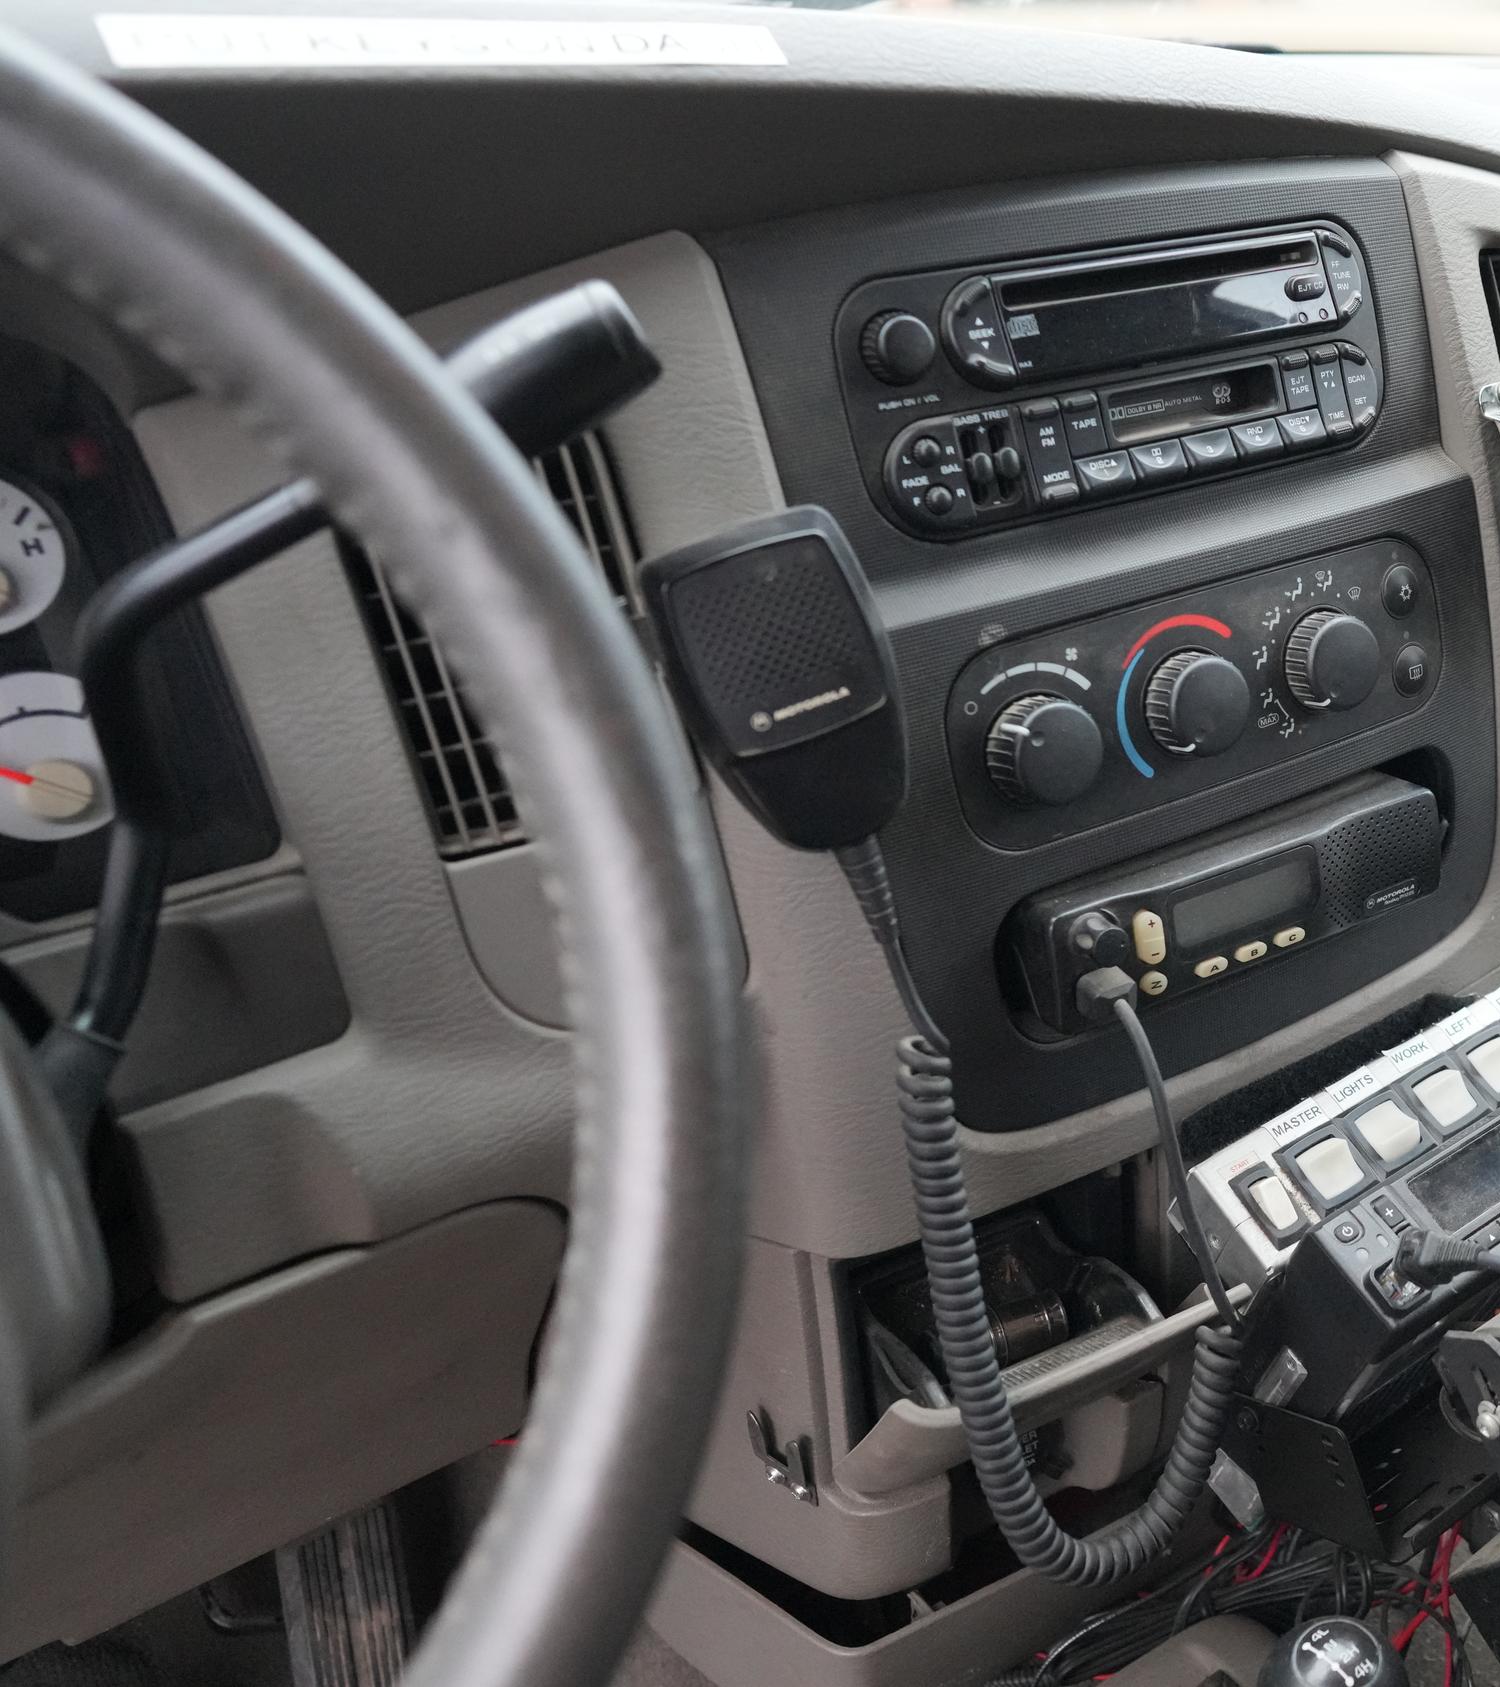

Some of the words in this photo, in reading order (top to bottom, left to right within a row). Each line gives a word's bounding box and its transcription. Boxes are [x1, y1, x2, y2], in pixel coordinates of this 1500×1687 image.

[1333, 271, 1351, 279] TUNE
[1297, 283, 1312, 292] EJT
[1313, 281, 1324, 290] CD
[1336, 282, 1349, 290] RW
[1291, 375, 1305, 385] EJT
[1320, 370, 1334, 379] PTY
[1347, 374, 1366, 384] SCAN
[1291, 385, 1310, 395] TAPE
[1164, 399, 1182, 407] AUTO
[1182, 395, 1202, 403] METAL
[1354, 397, 1367, 405] SET
[1127, 406, 1146, 415] DOLBY
[1327, 410, 1345, 421] TIME
[952, 414, 981, 427] BASS
[982, 408, 1009, 421] TREB
[1288, 417, 1306, 426] DISC
[1071, 418, 1097, 430] TAPE
[1040, 426, 1055, 436] AM
[1246, 426, 1264, 436] RND
[1041, 437, 1056, 447] FM
[1206, 445, 1214, 453] 3
[902, 455, 912, 465] L
[1089, 459, 1111, 470] DISC
[940, 463, 963, 475] BAL
[901, 475, 930, 489] FADE
[1043, 470, 1071, 483] MODE
[20, 537, 46, 558] H
[1376, 883, 1415, 904] MOTOROLA
[1288, 933, 1297, 942] C
[1250, 949, 1259, 957] B
[1209, 963, 1220, 973] A
[1444, 1016, 1473, 1037] LEFT
[1391, 1041, 1430, 1064] WORK
[1332, 1074, 1374, 1102] LIGHTS
[1271, 1105, 1322, 1137] MASTER
[1311, 1628, 1330, 1643] 4L
[1339, 1641, 1361, 1664] 2H
[1354, 1658, 1375, 1679] 4H
